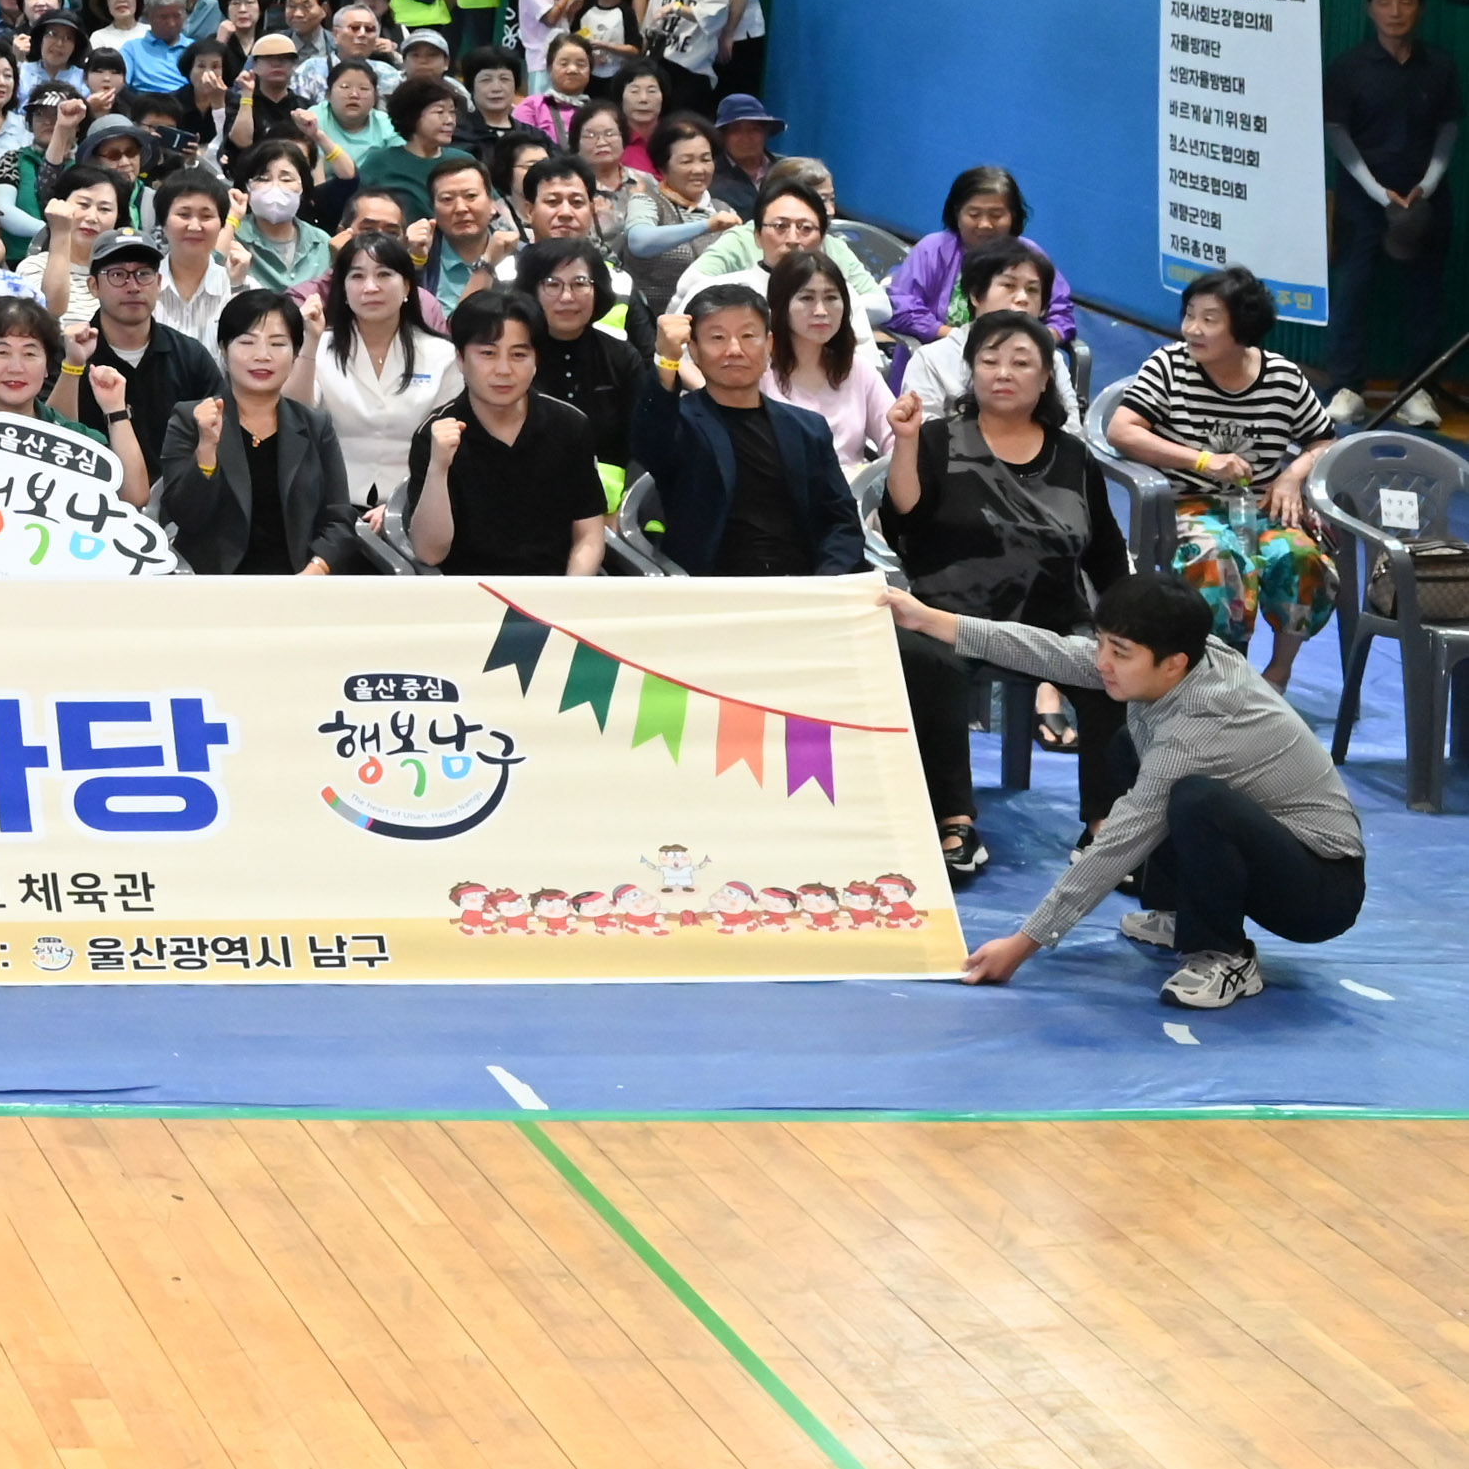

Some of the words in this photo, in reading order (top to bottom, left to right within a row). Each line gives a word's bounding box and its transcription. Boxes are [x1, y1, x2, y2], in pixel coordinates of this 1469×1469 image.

[1170, 0, 1273, 32] 지역사회보장협의체
[1169, 99, 1267, 134] 바르게살기위원회
[1169, 133, 1260, 168] 청소년지도협의회
[1169, 167, 1247, 201] 자연보호협의회
[1169, 201, 1221, 230] 재향군인회
[50, 441, 98, 475] 중심
[353, 678, 396, 700] 울산
[401, 678, 443, 700] 중심
[19, 871, 155, 913] 체육관
[88, 936, 291, 970] 울산광역시
[310, 935, 390, 968] 남구
